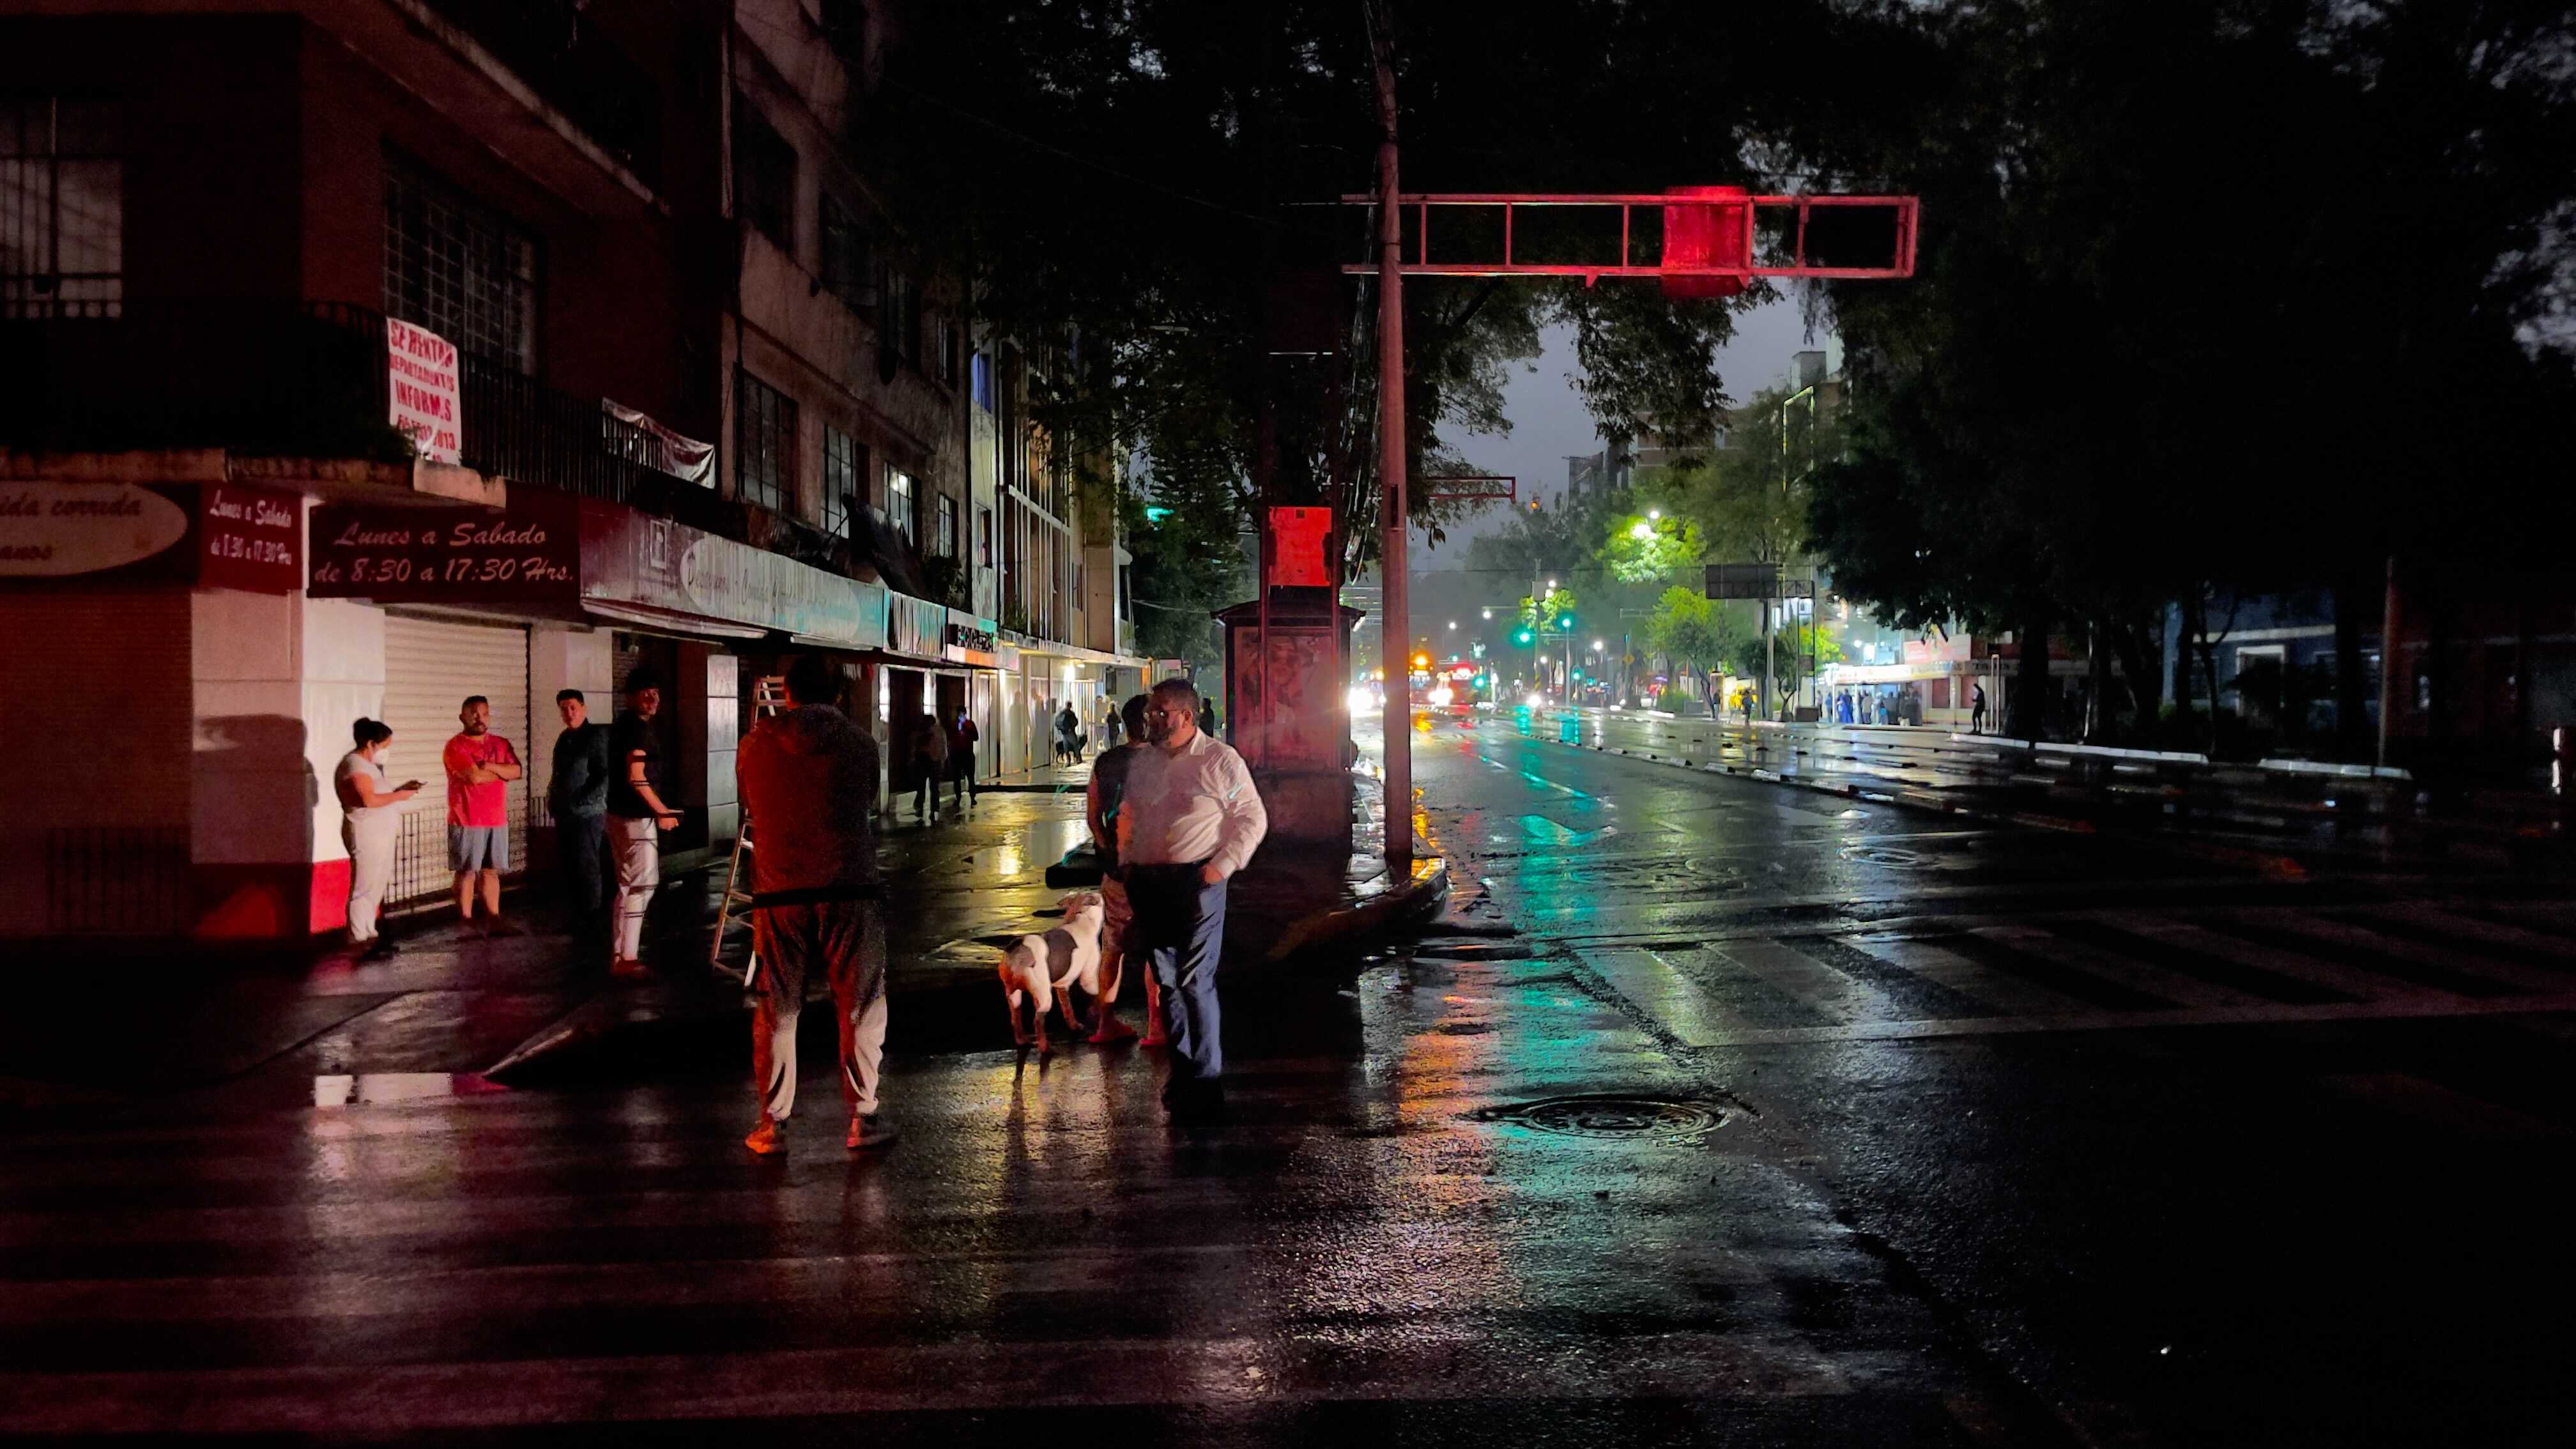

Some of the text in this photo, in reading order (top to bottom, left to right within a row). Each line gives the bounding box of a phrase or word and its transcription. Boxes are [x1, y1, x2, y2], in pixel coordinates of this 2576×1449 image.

[390, 320, 406, 350] SE
[395, 379, 452, 422] INFORMS
[332, 520, 548, 548] Lunes a Sabado
[313, 556, 574, 583] de 8:30 a 17:30 Hrs.
